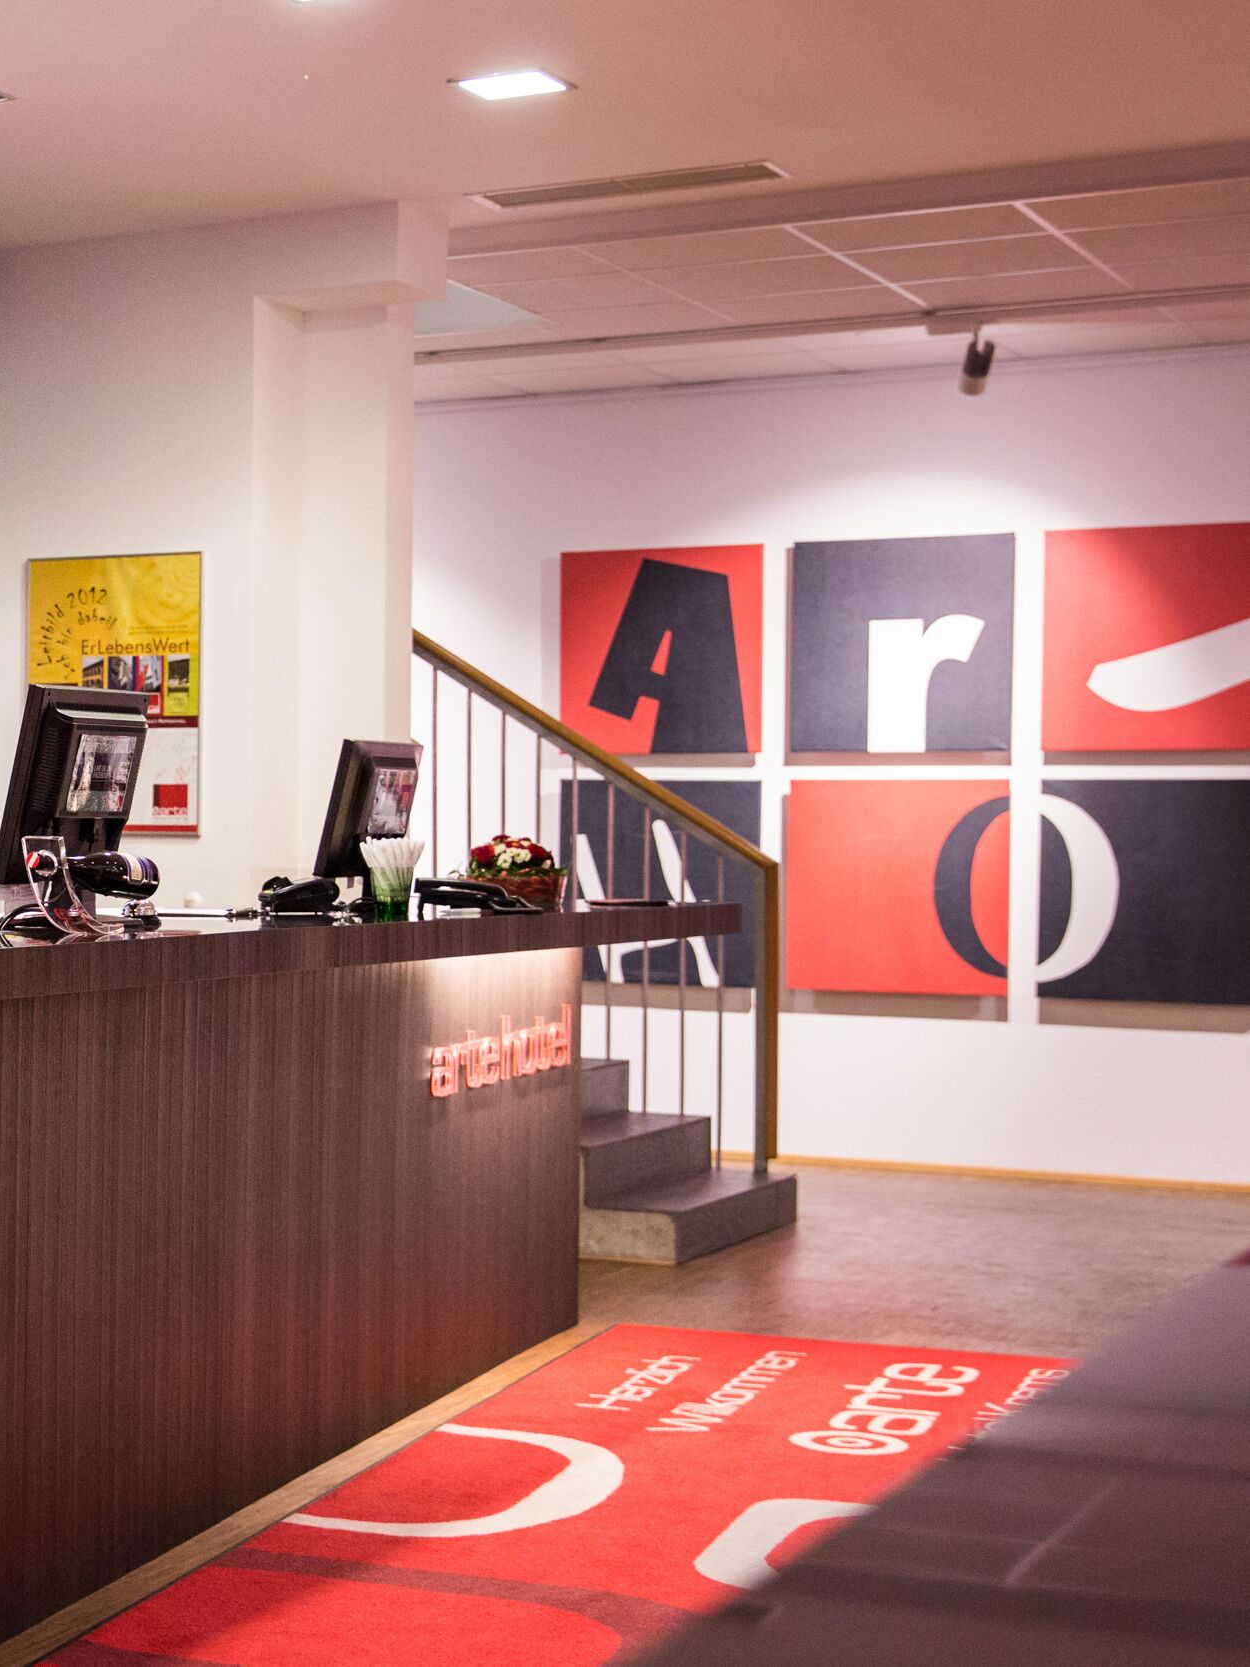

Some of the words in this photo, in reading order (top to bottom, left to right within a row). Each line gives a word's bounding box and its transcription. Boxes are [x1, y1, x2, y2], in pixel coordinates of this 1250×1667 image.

[67, 587, 109, 609] 2012
[81, 637, 190, 656] ErLebensWert
[575, 1354, 702, 1411] Herzlich
